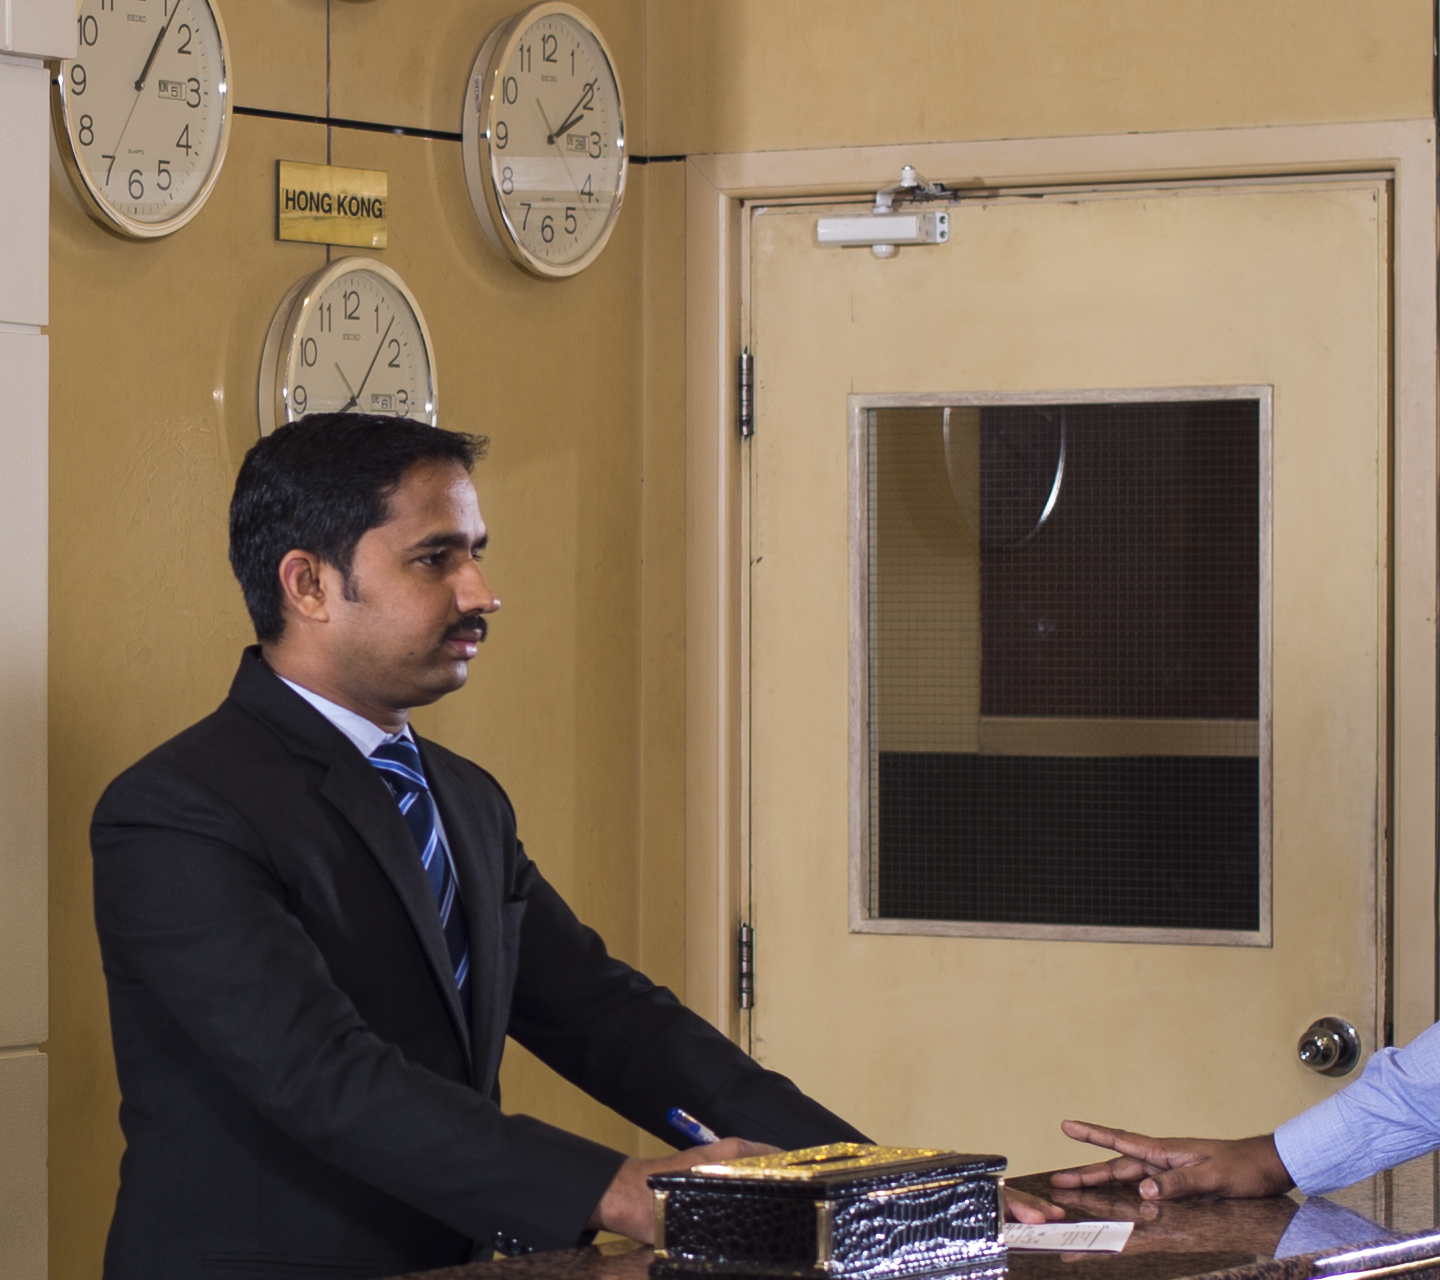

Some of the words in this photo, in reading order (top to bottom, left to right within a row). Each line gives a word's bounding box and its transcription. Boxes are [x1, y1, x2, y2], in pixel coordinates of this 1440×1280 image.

[78, 15, 98, 46] 10
[127, 14, 147, 23] SEIKO
[177, 24, 191, 55] 2
[541, 34, 557, 63] 12
[520, 44, 531, 73] 11
[571, 49, 575, 77] 1
[71, 64, 86, 96] 9
[186, 78, 201, 108] 3
[502, 76, 518, 104] 10
[583, 83, 594, 111] 2
[79, 115, 94, 146] 8
[176, 124, 192, 156] 4
[496, 121, 508, 149] 9
[589, 132, 601, 159] 3
[102, 154, 115, 186] 7
[128, 169, 143, 200] 6
[157, 160, 171, 190] 5
[502, 166, 514, 195] 8
[581, 174, 593, 203] 4
[285, 189, 332, 214] HONG
[337, 194, 382, 219] KONG
[520, 203, 531, 231] 7
[541, 215, 554, 243] 6
[565, 207, 576, 234] 5
[319, 303, 331, 332] 11
[343, 291, 360, 320] 12
[375, 305, 378, 334] 1
[300, 338, 317, 367] 10
[388, 339, 400, 368] 2
[294, 385, 307, 414] 9
[396, 389, 409, 417] 3
